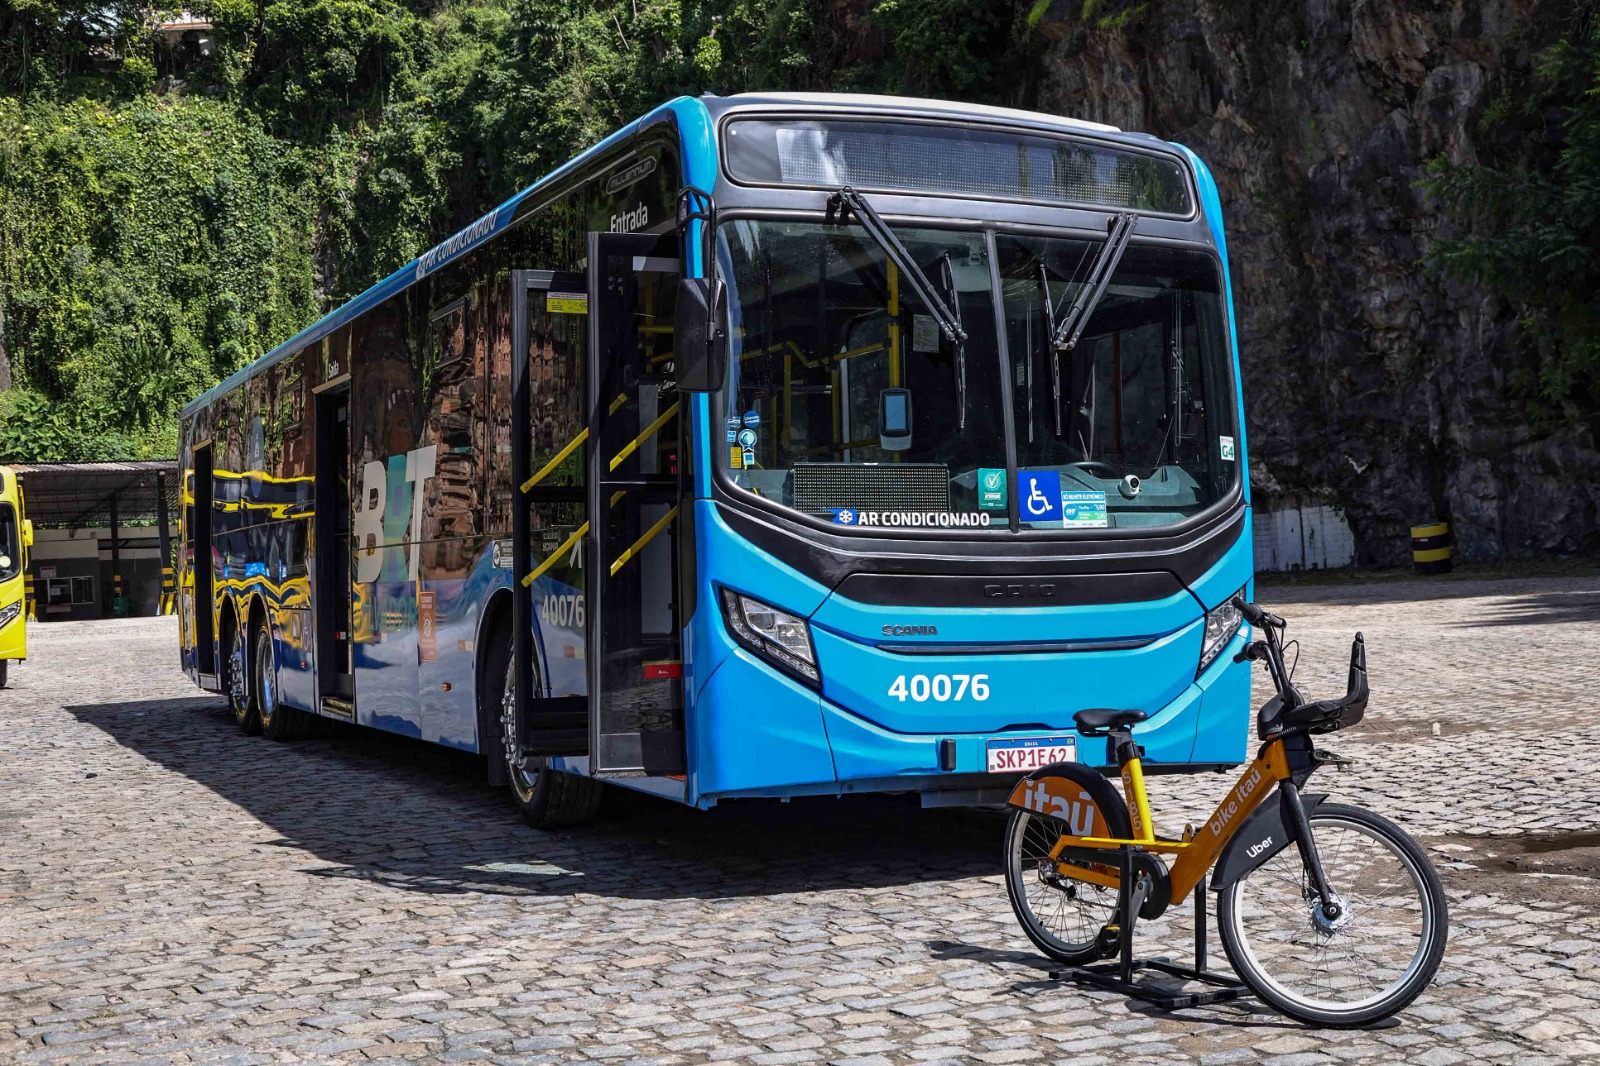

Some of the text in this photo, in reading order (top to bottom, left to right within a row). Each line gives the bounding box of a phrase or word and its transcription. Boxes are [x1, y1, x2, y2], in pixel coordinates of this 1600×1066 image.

[611, 202, 648, 233] Entrada
[1222, 445, 1234, 457] G4
[354, 445, 437, 583] BRT
[858, 512, 990, 526] AR CONDICIONADO
[542, 594, 585, 628] 40076
[882, 624, 938, 636] SCANIA
[888, 674, 990, 702] 40076
[996, 748, 1067, 768] SKP1E62
[1024, 779, 1094, 837] itaú
[1210, 767, 1262, 836] bike itaú
[1246, 836, 1273, 857] Uber
